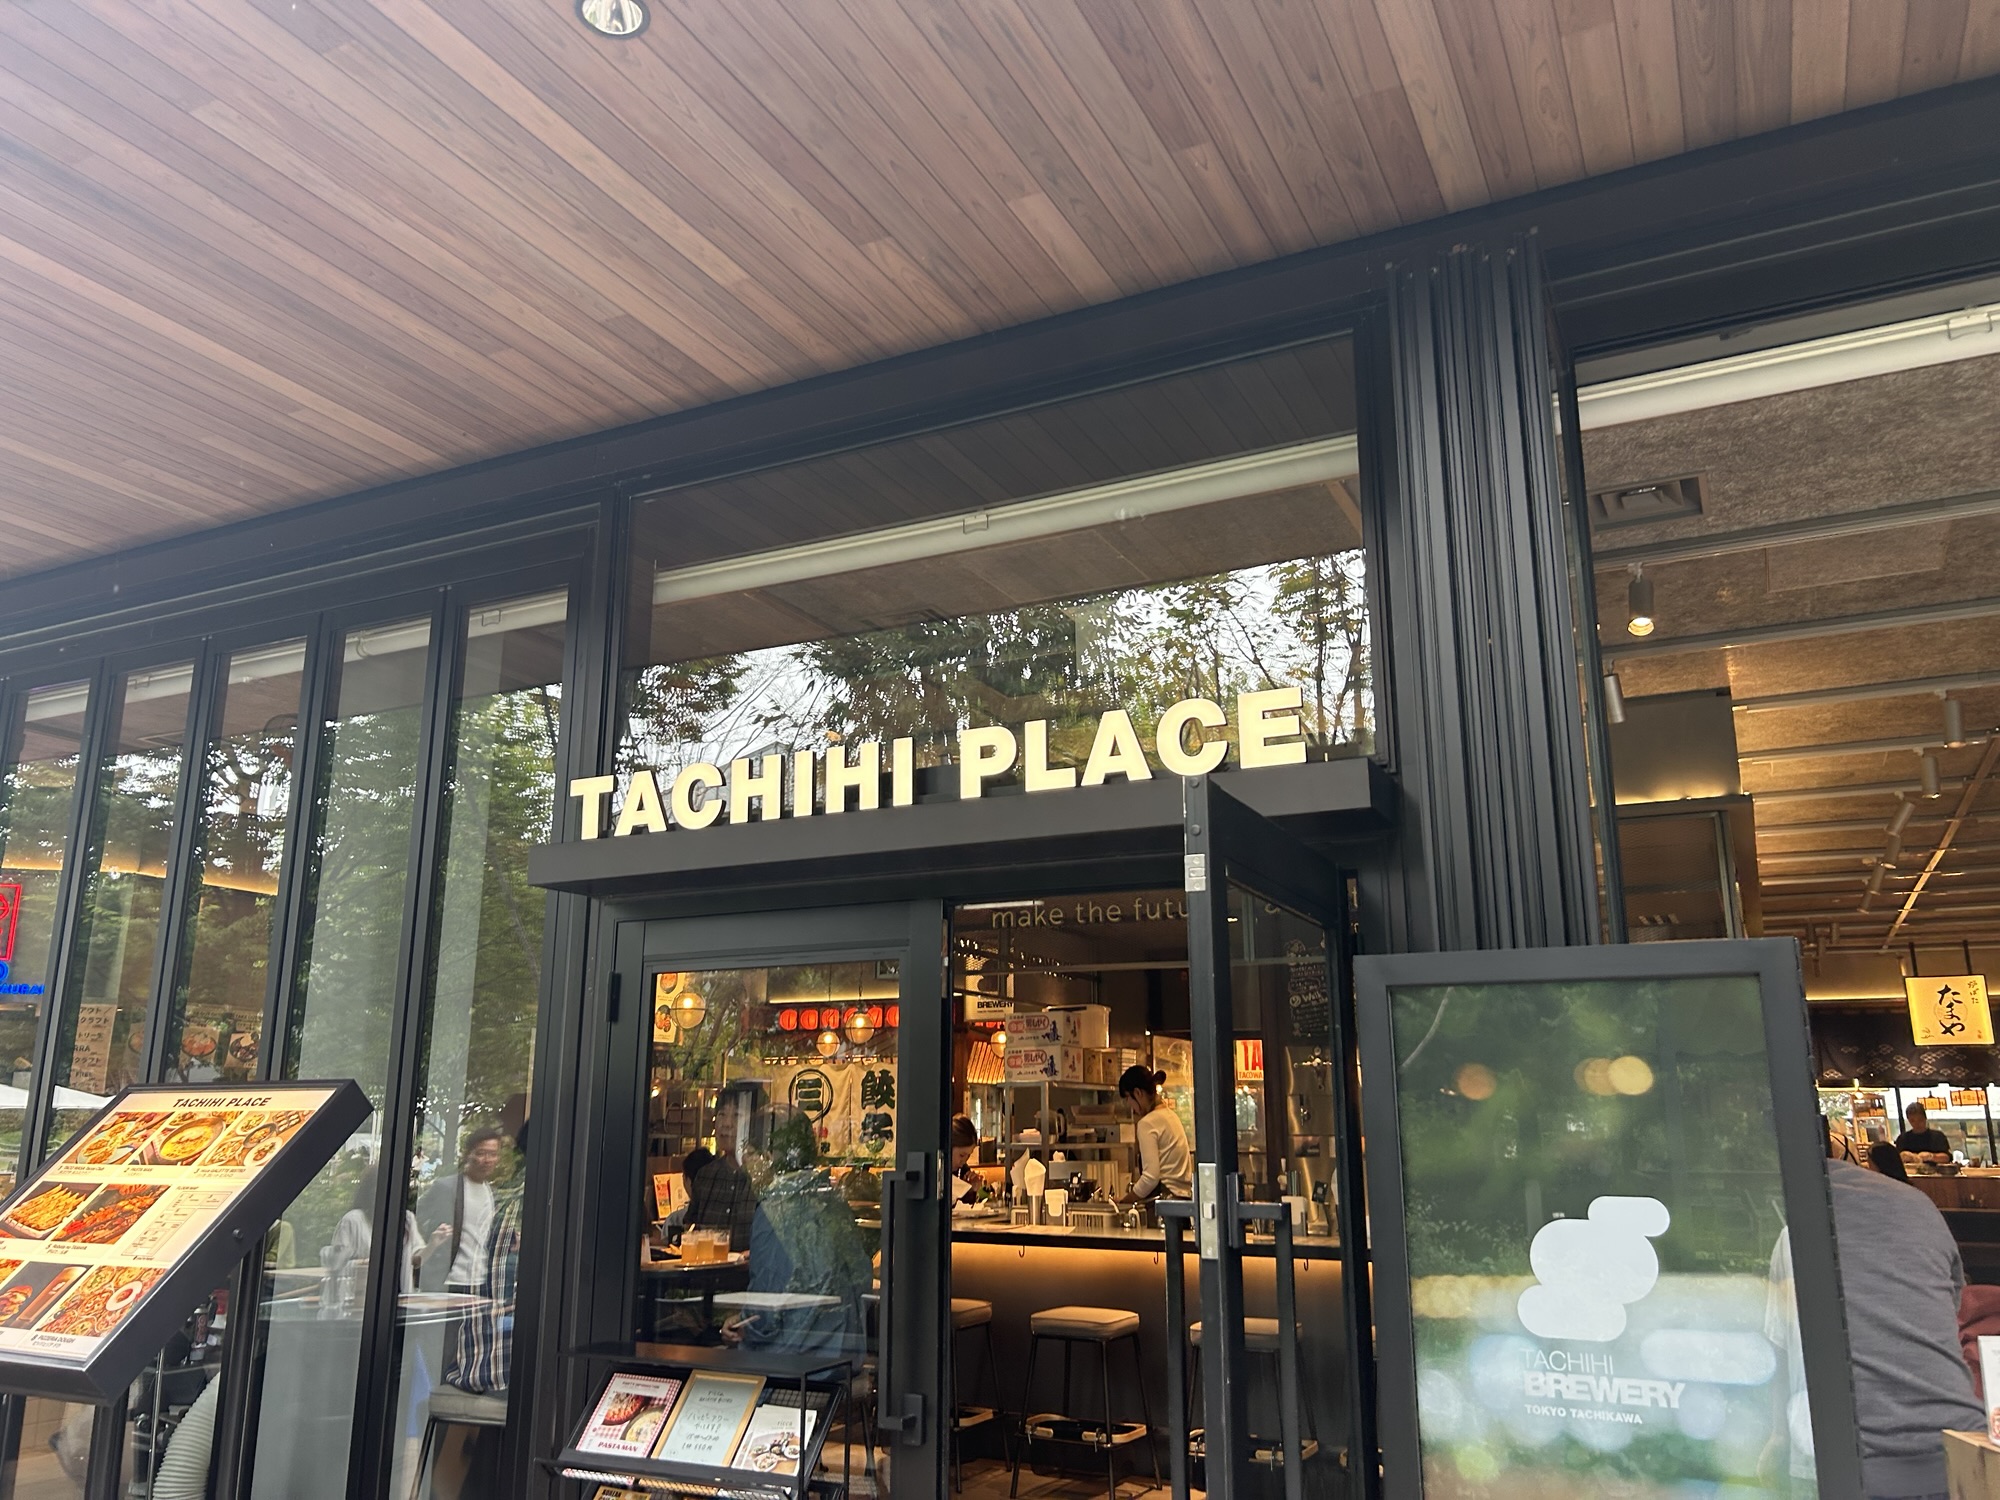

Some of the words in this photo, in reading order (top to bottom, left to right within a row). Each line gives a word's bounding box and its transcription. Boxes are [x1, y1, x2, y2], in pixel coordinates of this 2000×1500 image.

[570, 737, 914, 840] TACHIHI
[959, 687, 1307, 799] PLACE
[992, 904, 1064, 928] make
[1075, 901, 1122, 924] the
[1936, 984, 1966, 1037] たまや
[173, 1098, 227, 1108] TACHIHI
[226, 1097, 272, 1107] PLACE
[1521, 1349, 1614, 1374] TACHIHI
[1524, 1371, 1686, 1409] BREWERY
[1524, 1404, 1567, 1418] TOKYO
[1570, 1408, 1643, 1425] TACHIKAWA
[598, 1441, 621, 1450] PASTA
[621, 1444, 638, 1452] MAN
